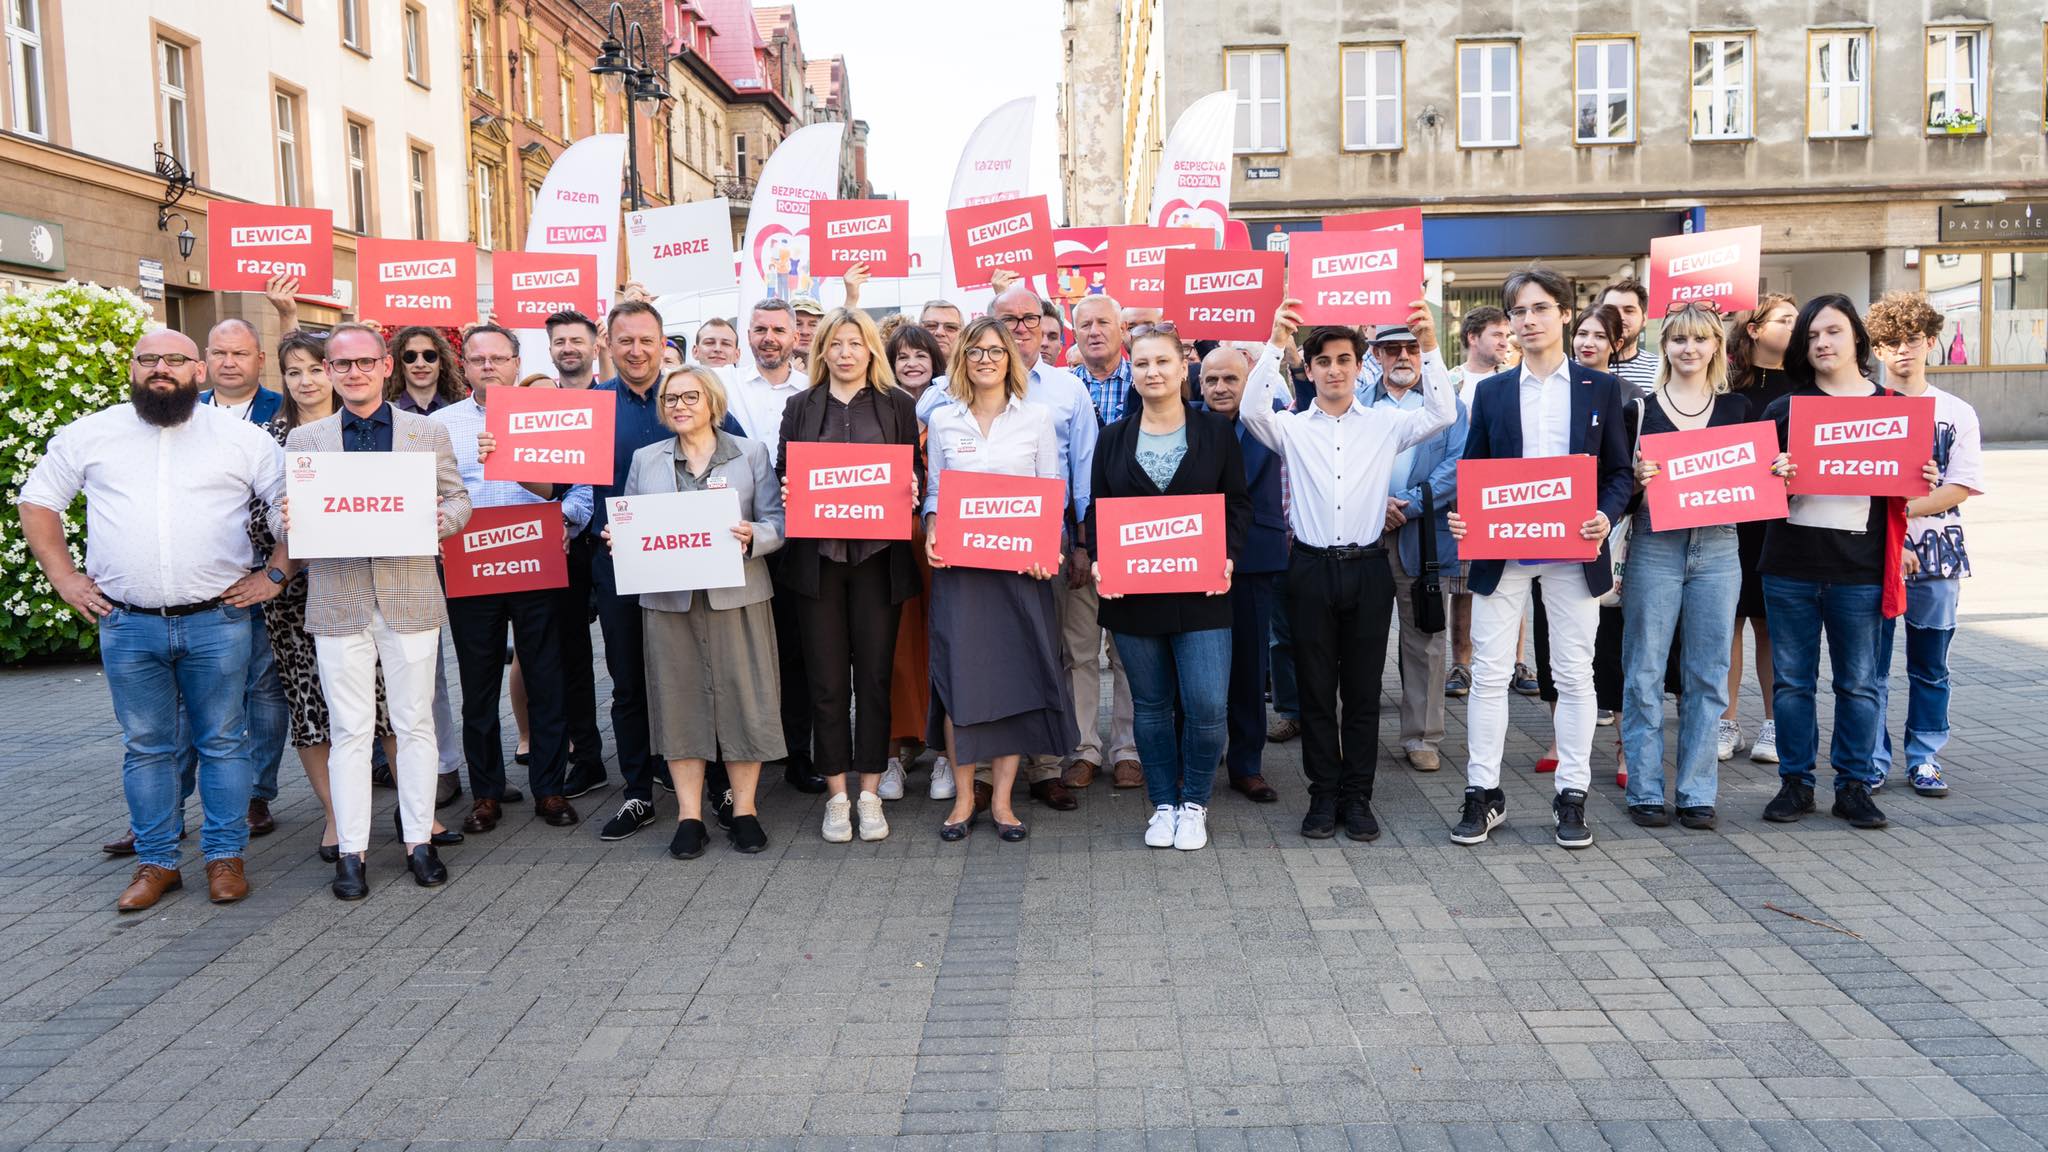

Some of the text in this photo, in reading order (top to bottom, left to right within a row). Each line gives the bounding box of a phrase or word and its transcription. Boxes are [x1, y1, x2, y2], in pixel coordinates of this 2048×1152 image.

[556, 189, 600, 204] razem
[771, 185, 828, 201] BEZPIECZNA
[778, 202, 811, 214] RODZI
[236, 228, 307, 243] LEWICA
[549, 227, 604, 242] LEWICA
[831, 218, 888, 235] LEWICA
[971, 216, 1030, 243] LEWICA
[653, 238, 710, 259] ZABRZE
[831, 249, 887, 262] razem
[1130, 250, 1165, 264] LEW
[976, 247, 1033, 269] razem
[1318, 253, 1393, 274] LEWICA
[1673, 247, 1736, 273] LEWICA
[237, 259, 306, 276] razem
[384, 262, 452, 278] LEWICA
[516, 272, 576, 288] LEWICA
[1190, 272, 1258, 291] LEWICA
[1317, 290, 1392, 306] razem
[1672, 281, 1733, 300] razem
[385, 293, 452, 309] razem
[517, 300, 575, 314] razem
[1189, 306, 1256, 323] razem
[514, 412, 588, 430] LEWICA
[1820, 420, 1903, 442] LEWICA
[514, 447, 585, 464] razem
[1674, 447, 1751, 476] LEWICA
[1819, 458, 1899, 476] razem
[815, 467, 886, 486] LEWICA
[1487, 481, 1567, 505] LEWICA
[1678, 485, 1755, 508] razem
[323, 496, 404, 513] ZABRZE
[814, 503, 884, 520] razem
[965, 500, 1037, 515] LEWICA
[468, 524, 539, 549] LEWICA
[1125, 518, 1198, 542] LEWICA
[1488, 521, 1566, 539] razem
[641, 532, 712, 552] ZABRZE
[962, 531, 1033, 552] razem
[472, 558, 541, 578] razem
[1127, 556, 1198, 574] razem
